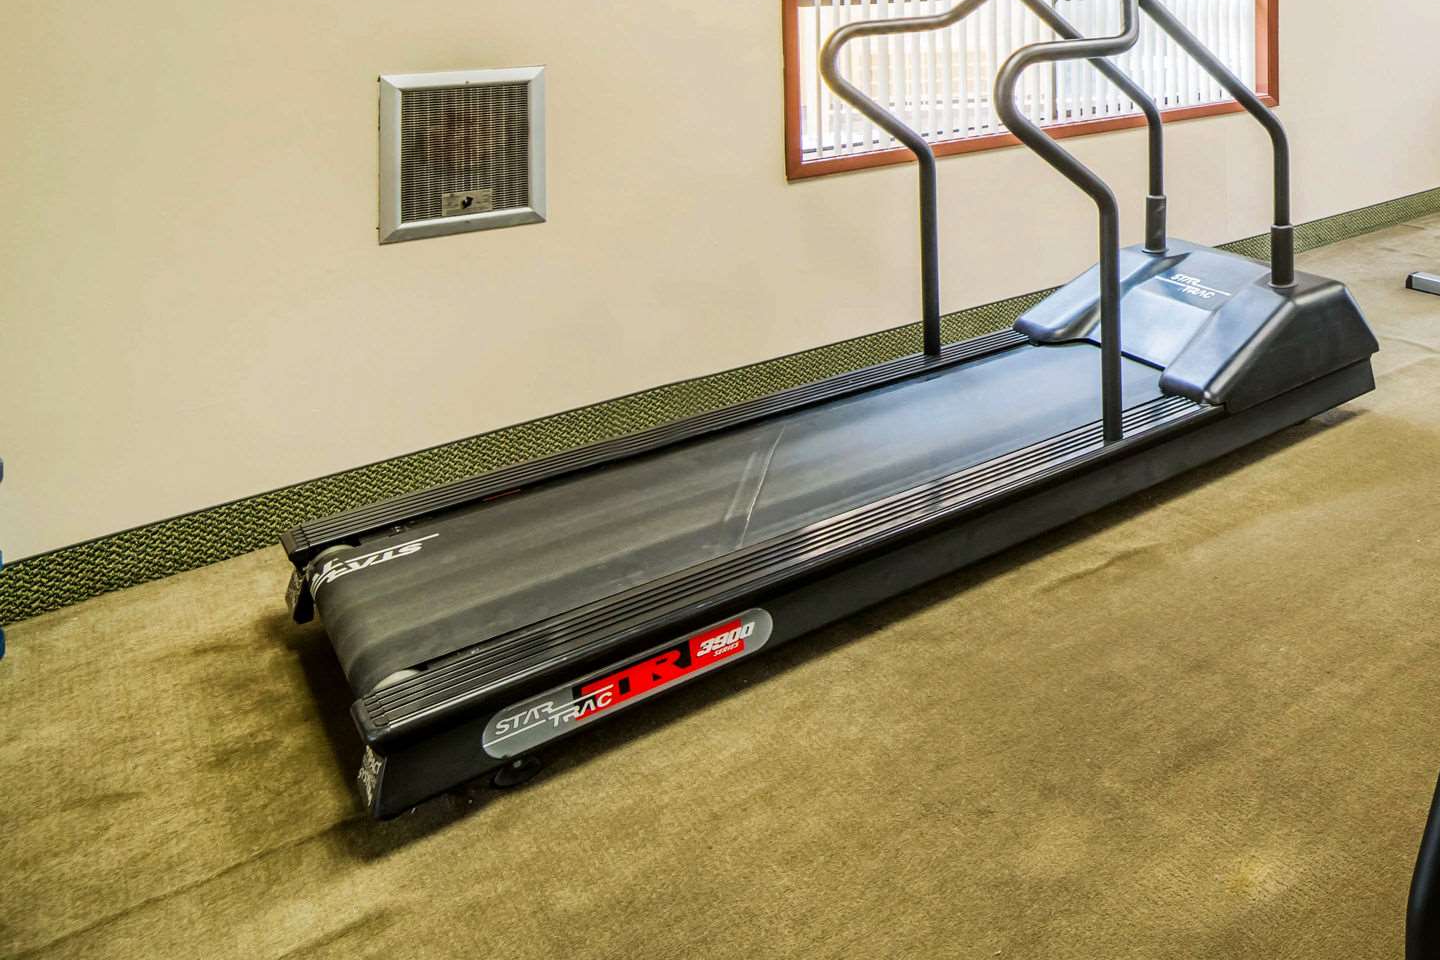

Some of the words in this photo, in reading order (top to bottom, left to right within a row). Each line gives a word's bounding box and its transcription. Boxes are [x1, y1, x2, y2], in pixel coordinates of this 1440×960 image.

[696, 622, 755, 657] 3900
[713, 642, 740, 657] SERIES
[495, 700, 555, 736] STAR
[550, 691, 613, 728] TRAC
